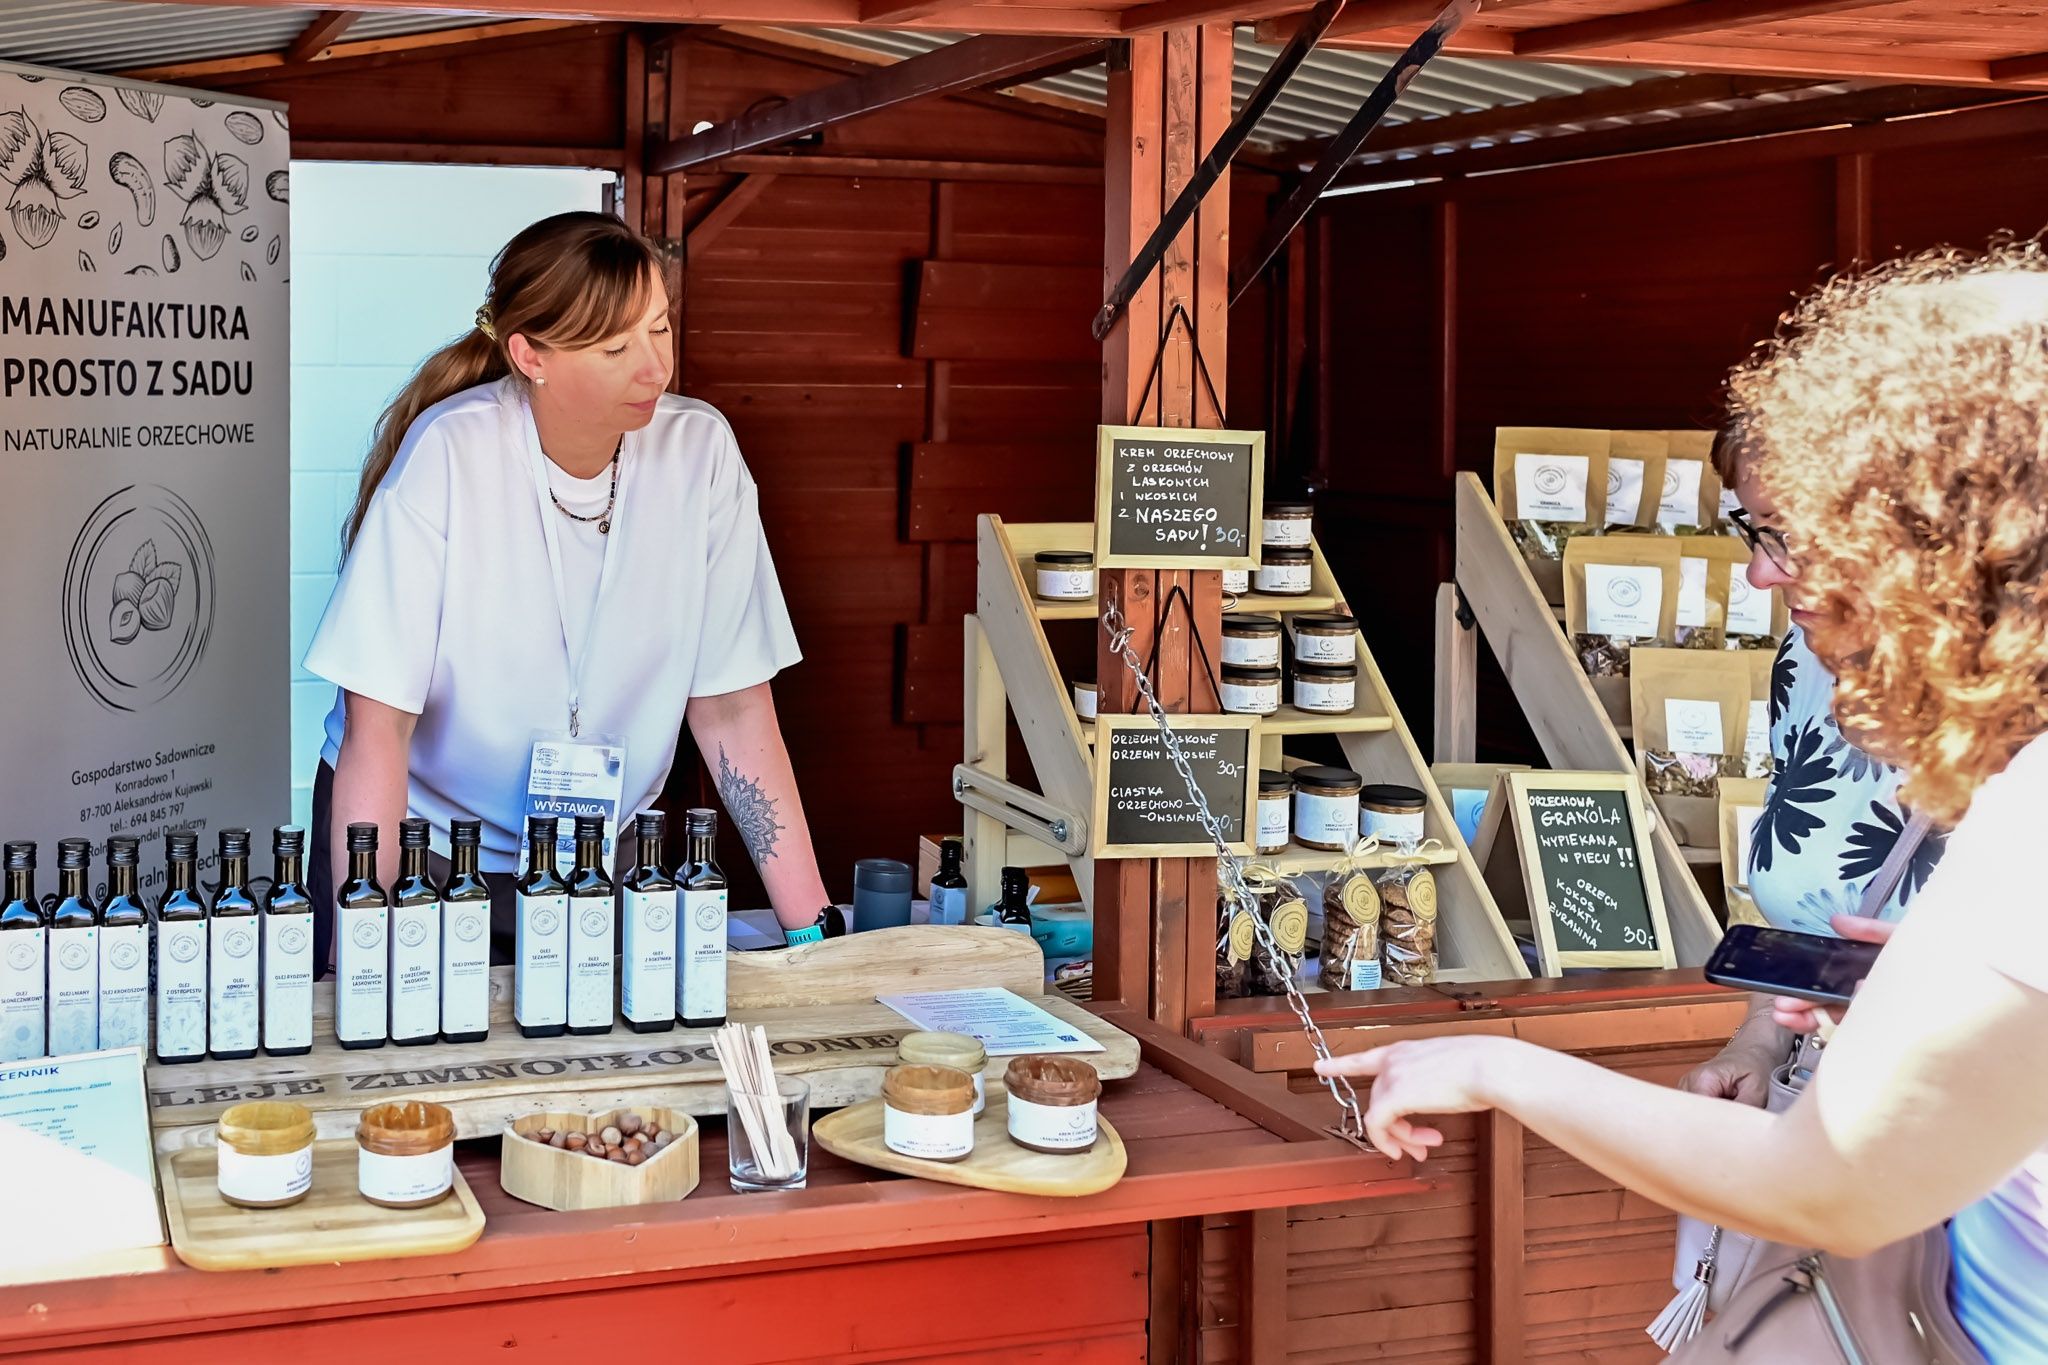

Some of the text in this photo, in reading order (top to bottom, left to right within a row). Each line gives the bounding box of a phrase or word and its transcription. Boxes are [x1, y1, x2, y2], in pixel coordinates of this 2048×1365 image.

[2, 296, 250, 340] MANUFAKTURA
[4, 358, 252, 396] PROSTO Z SADU
[4, 423, 254, 451] NATURALNIE ORZECHOWE
[1120, 448, 1234, 463] KREM ORZECHOWY
[1142, 461, 1203, 474] ORZECHÓW
[1132, 476, 1210, 488] LASKOWYCH
[1136, 492, 1198, 502] WŁOSKICH
[1136, 508, 1218, 524] NASZEGO
[1111, 734, 1159, 745] ORZECHY
[71, 742, 215, 786] Gospodarstwo Sadownicze
[1112, 750, 1217, 760] ORZECHY WOSKIE
[115, 770, 176, 794] Konradowo 1
[80, 778, 213, 822] 87-700 Aleksandrów Kujawski
[1111, 787, 1164, 798] CIASTKA
[534, 800, 606, 816] WYSTAWCA
[1529, 796, 1595, 808] ORZECHOWA
[130, 812, 148, 828] 694
[150, 808, 166, 822] 845
[170, 802, 184, 817] 797
[1541, 806, 1621, 827] GRANOLA
[1540, 834, 1618, 848] WYPIEKANA
[1574, 852, 1610, 864] PIECU
[1556, 878, 1596, 913] KOKOS
[1576, 878, 1618, 910] ORZECH
[1562, 897, 1602, 934] DAKTYL
[152, 1078, 325, 1108] LEJE
